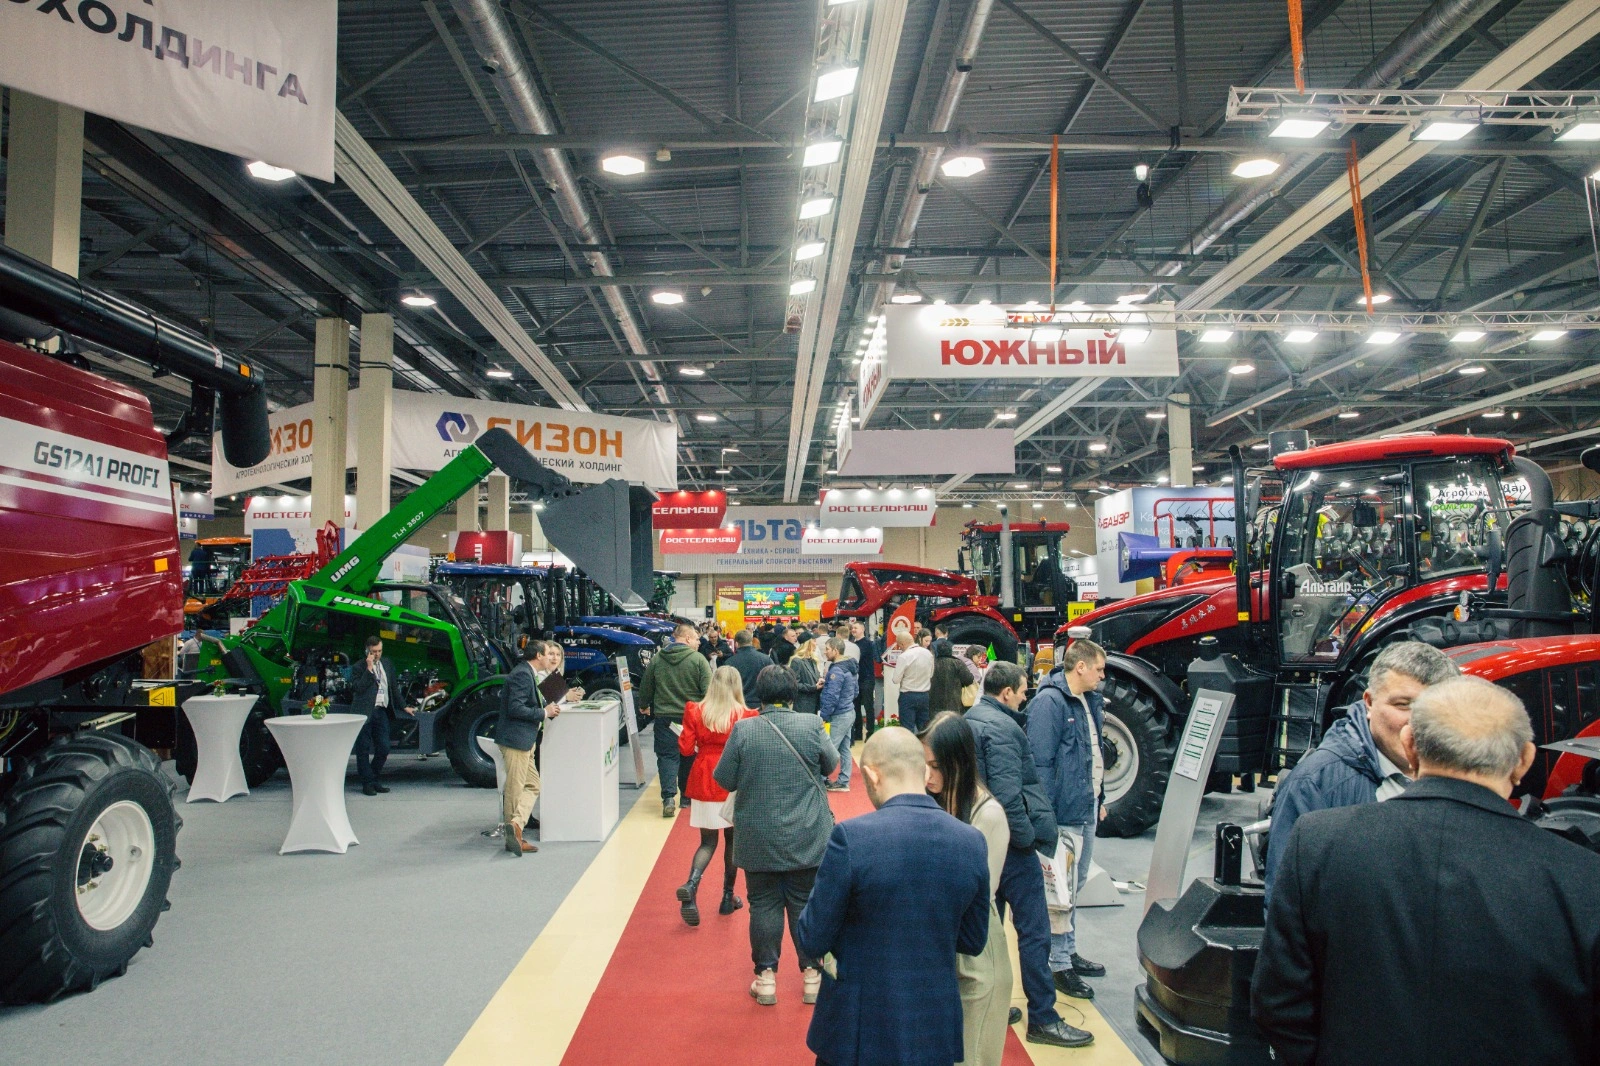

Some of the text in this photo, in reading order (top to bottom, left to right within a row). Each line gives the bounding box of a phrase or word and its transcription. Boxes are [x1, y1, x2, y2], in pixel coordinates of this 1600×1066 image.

[8, 0, 308, 105] ХОЛДИНГА
[941, 332, 1127, 365] ЮЖНЫЙ
[33, 440, 160, 488] GS12A1 PROFI
[578, 460, 623, 473] ХОЛДИНГ
[652, 506, 719, 515] СЕЛЬМАШ
[828, 504, 928, 513] РОСТСЕЛЬМАШ
[392, 511, 425, 540] TLH 3507
[330, 555, 360, 583] UMG
[1300, 579, 1352, 593] Альтаир
[333, 596, 391, 611] UMG
